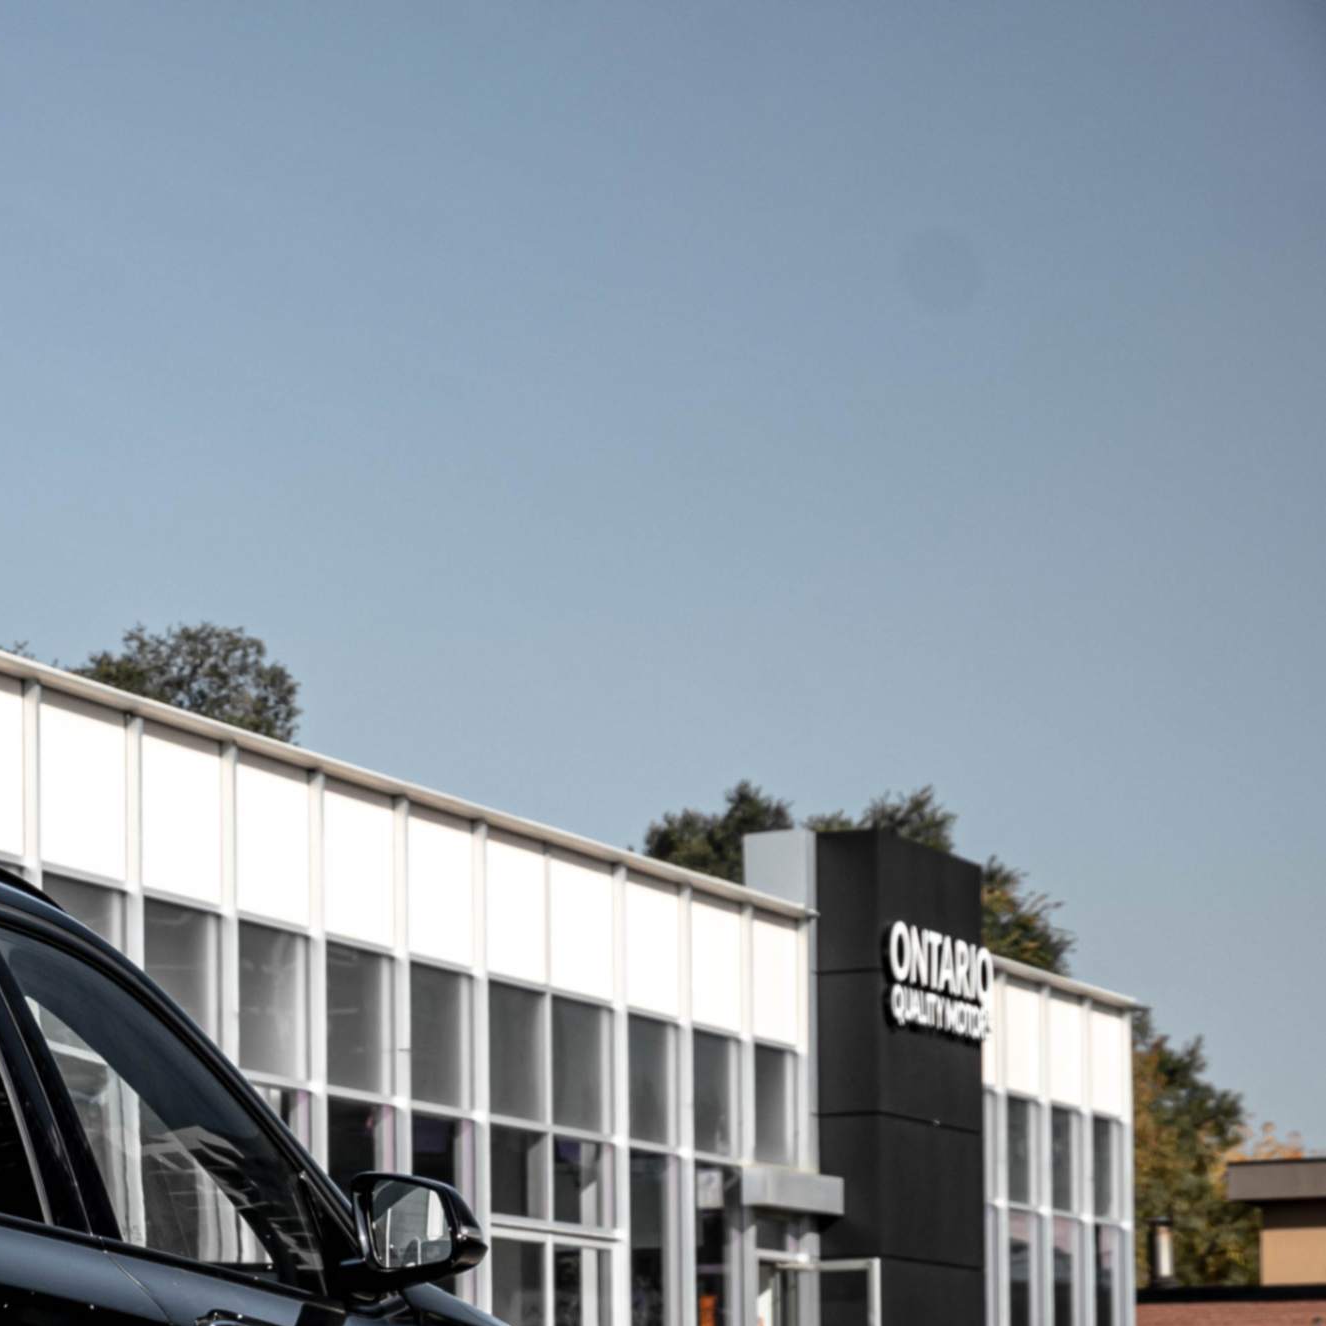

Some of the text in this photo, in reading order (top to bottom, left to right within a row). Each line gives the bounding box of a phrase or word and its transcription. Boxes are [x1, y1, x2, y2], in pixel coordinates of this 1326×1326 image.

[889, 920, 995, 1003] ONTARIO
[890, 983, 994, 1042] QUALITY MOTOR
